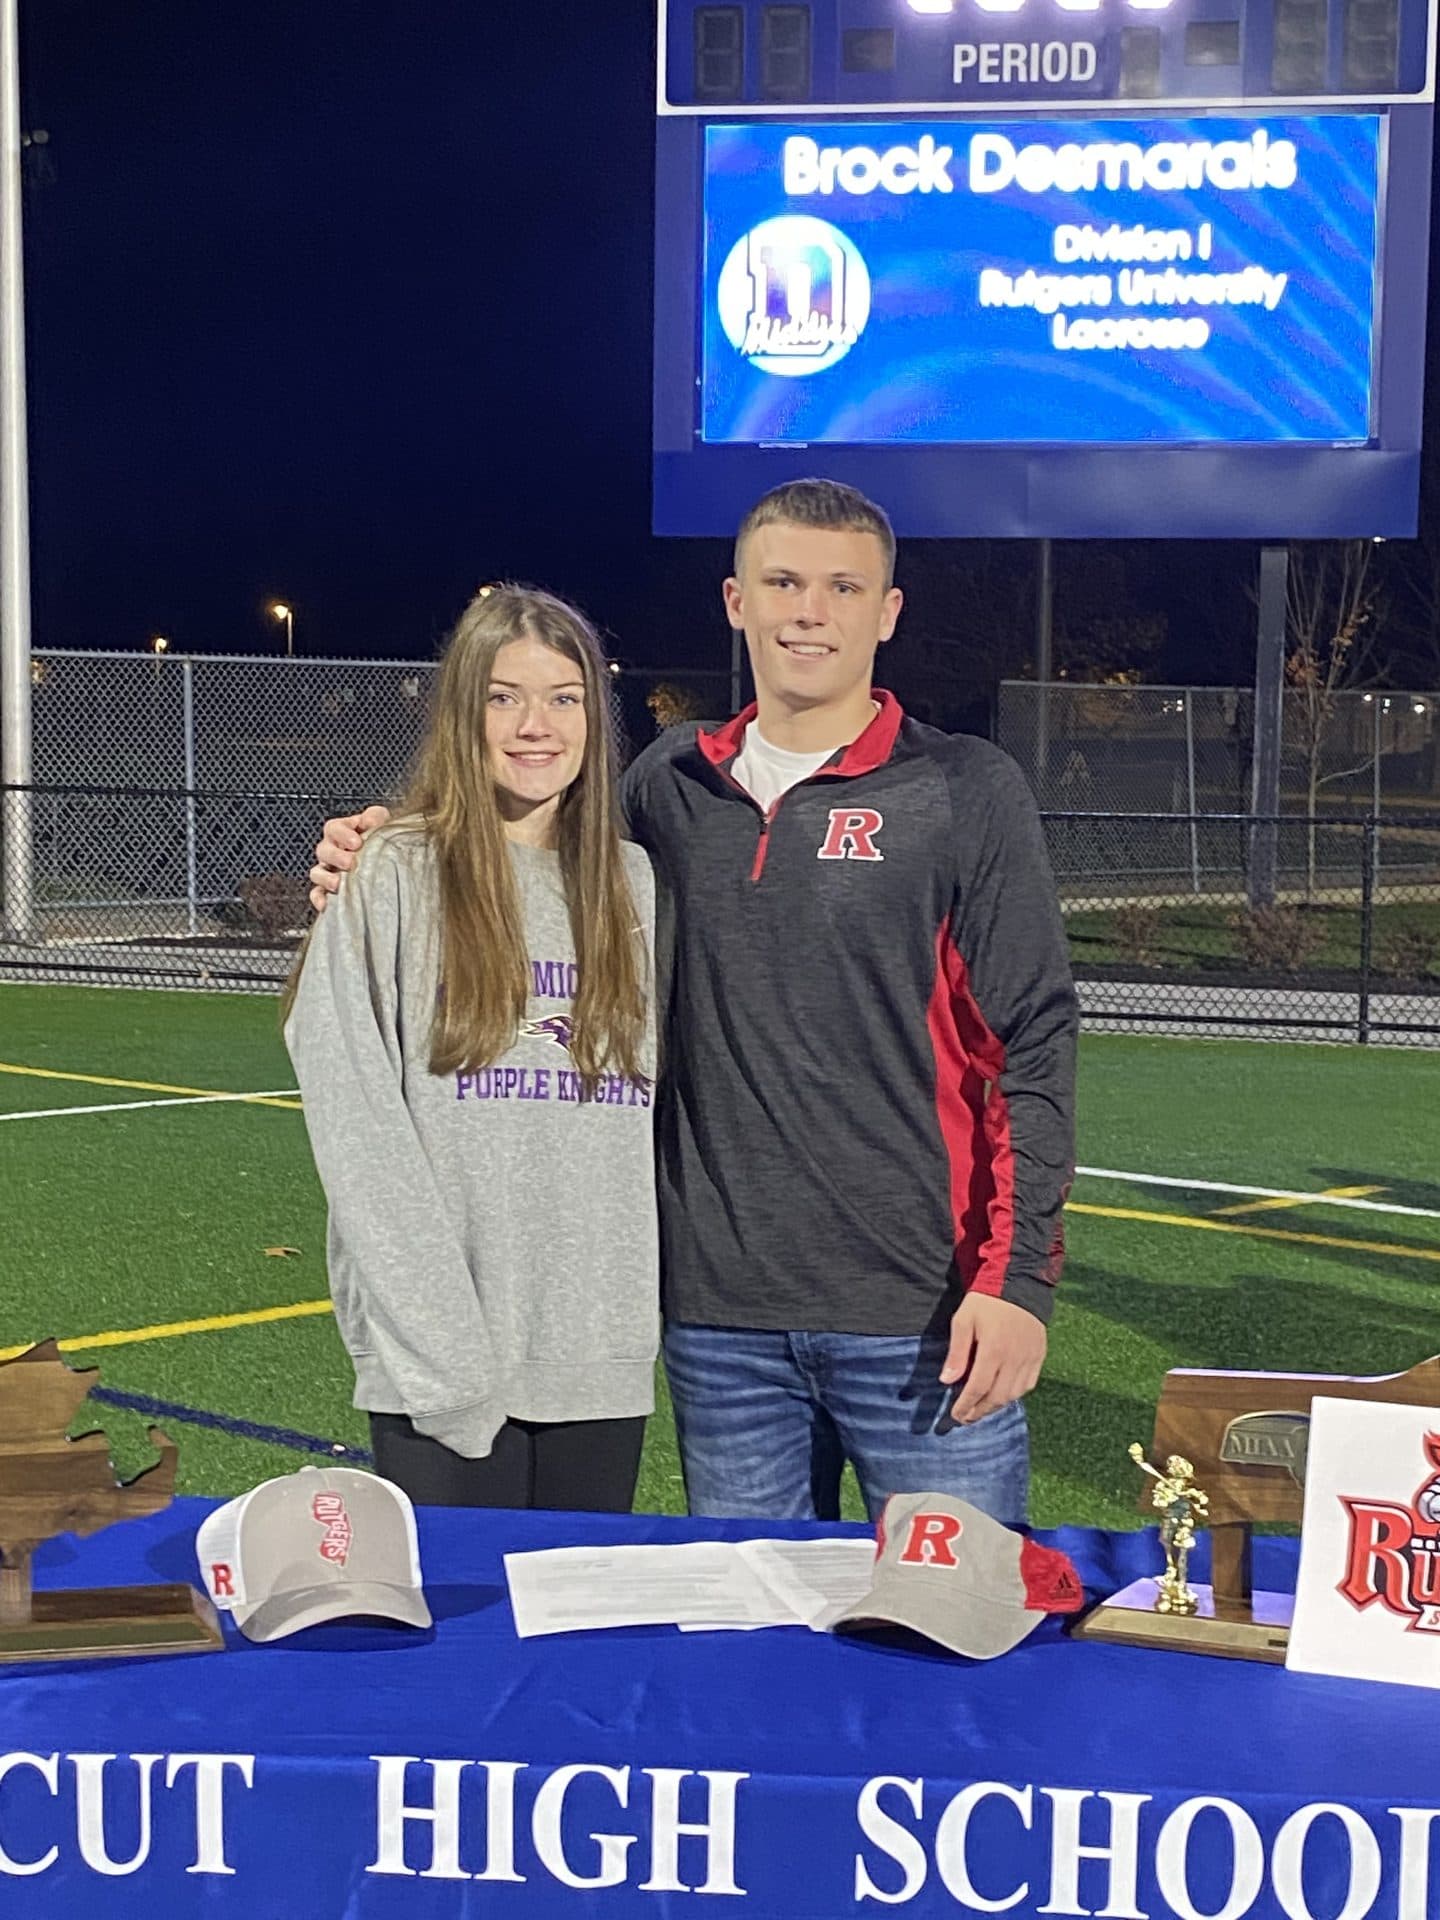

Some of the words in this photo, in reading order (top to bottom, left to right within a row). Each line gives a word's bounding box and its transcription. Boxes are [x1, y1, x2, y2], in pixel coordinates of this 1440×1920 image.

[953, 42, 1097, 84] PERIOD
[784, 135, 953, 194] Brock
[969, 129, 1297, 192] Desmarais
[1054, 225, 1191, 263] Division
[979, 268, 1112, 313] Rutgers
[1117, 266, 1287, 310] University
[1052, 313, 1209, 350] Lacrosse
[817, 808, 884, 861] R
[455, 1068, 550, 1100] PURPLE
[557, 1070, 651, 1108] KNGHTS
[315, 1495, 349, 1558] RUTGERS
[898, 1512, 963, 1569] R
[211, 1564, 235, 1596] R
[0, 1751, 255, 1876] CUT
[365, 1755, 750, 1895] HIGH
